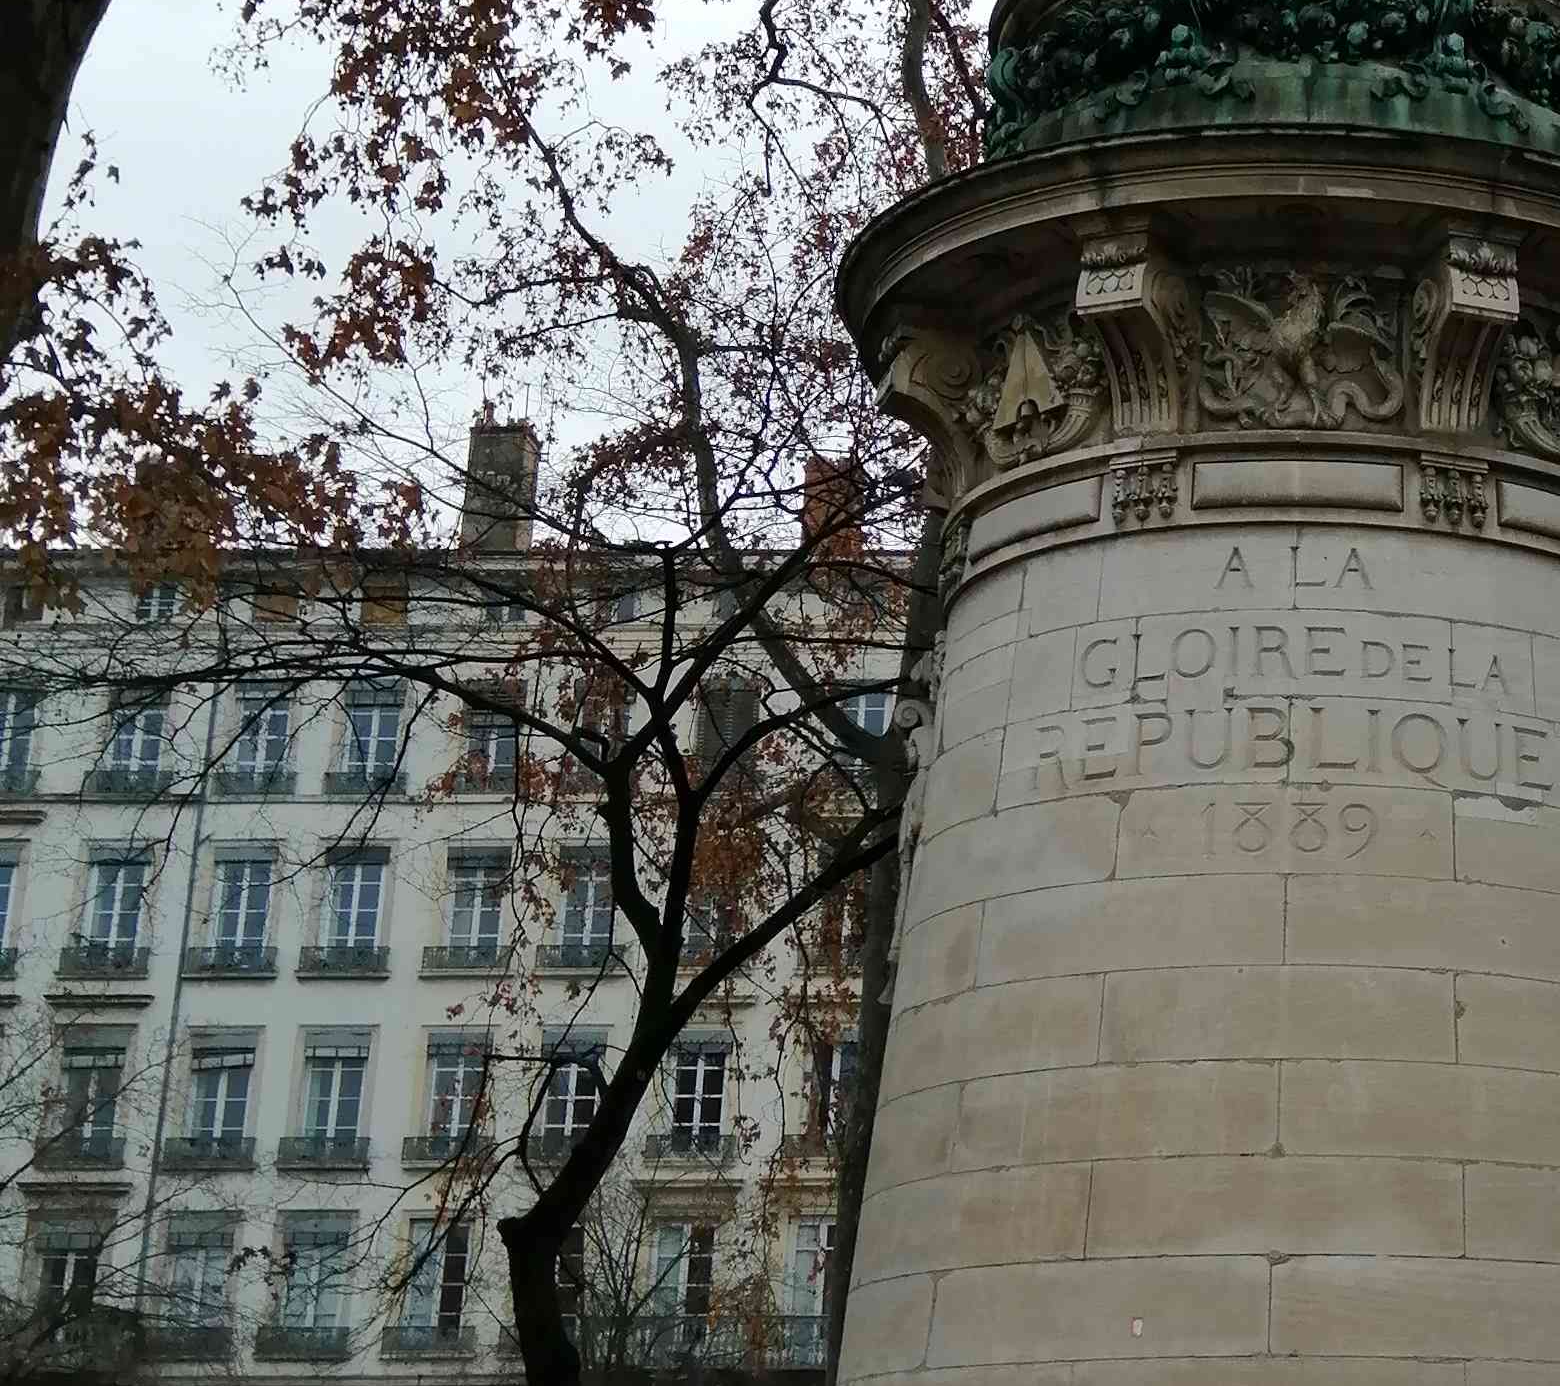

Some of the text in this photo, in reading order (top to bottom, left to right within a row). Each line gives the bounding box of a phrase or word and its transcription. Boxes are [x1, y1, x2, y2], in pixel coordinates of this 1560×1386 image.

[1213, 546, 1374, 590] A LA
[1081, 625, 1509, 693] GLOIRE DE LA
[1034, 706, 1553, 790] REPUBLIQUE
[1201, 801, 1378, 861] 1889
